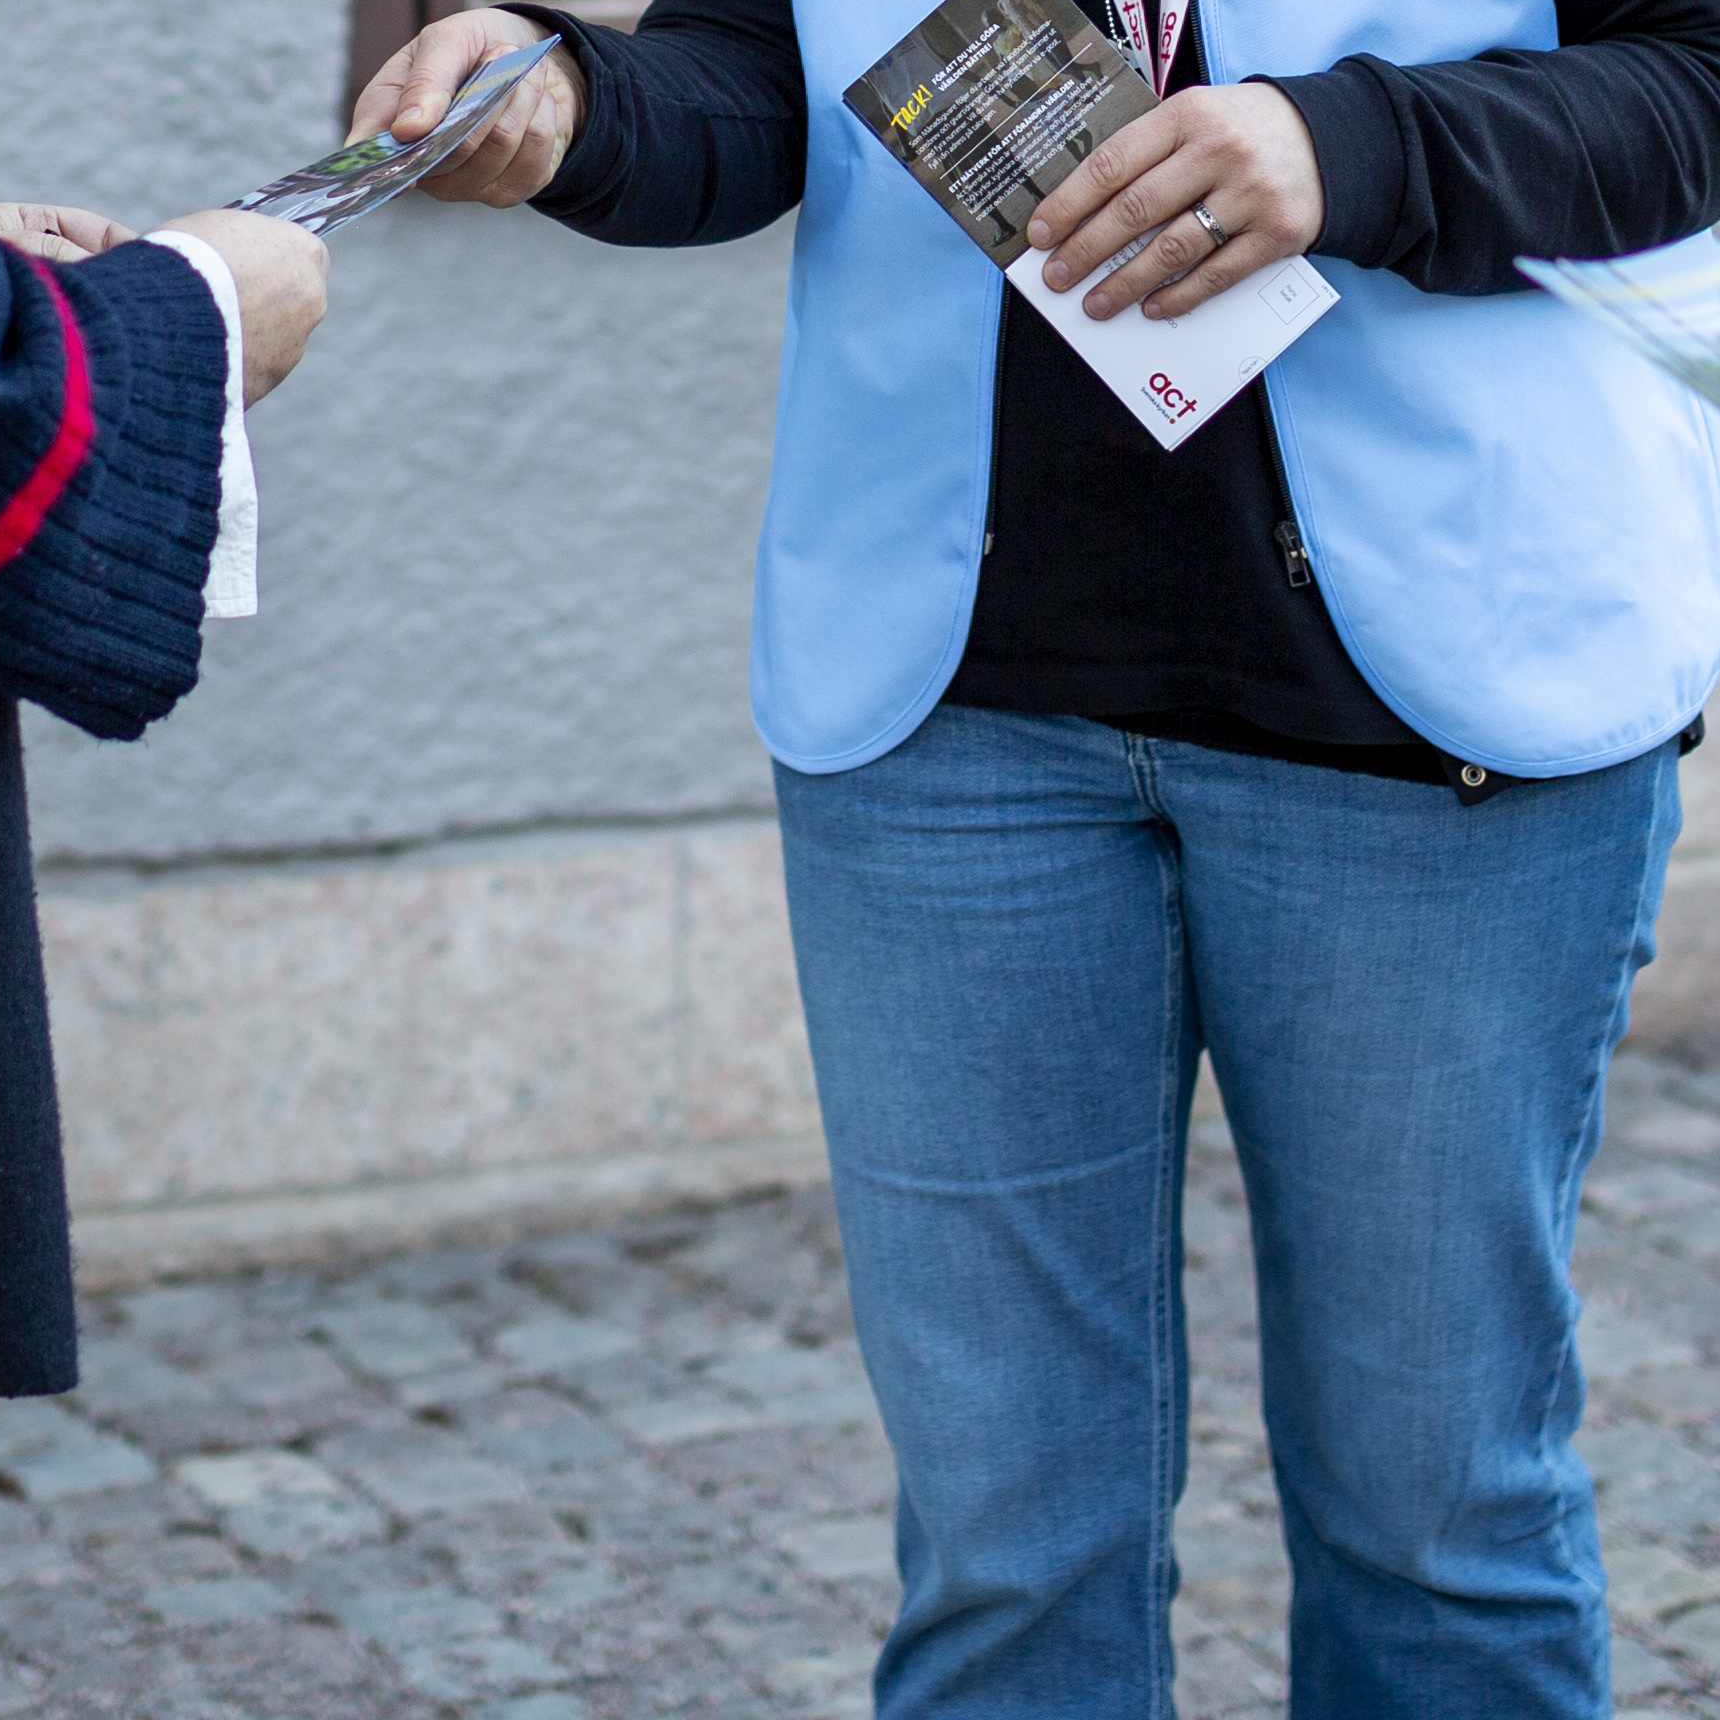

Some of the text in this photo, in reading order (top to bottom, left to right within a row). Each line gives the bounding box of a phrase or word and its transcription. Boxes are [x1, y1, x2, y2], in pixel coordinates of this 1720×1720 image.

[1122, 1, 1142, 50] act
[1161, 12, 1177, 63] act
[930, 69, 947, 85] FÖR
[943, 59, 959, 74] ATT
[965, 38, 981, 54] VILL
[977, 21, 1000, 42] GÖRA
[937, 41, 993, 92] VÄRLDEN BÄTTRE!
[947, 77, 1075, 193] ETT NÄTVERK FÖR ATT FÖRÄNDRA VÄRLDEN
[1141, 386, 1170, 419] Svenska kyrkan
[1149, 372, 1197, 418] act
